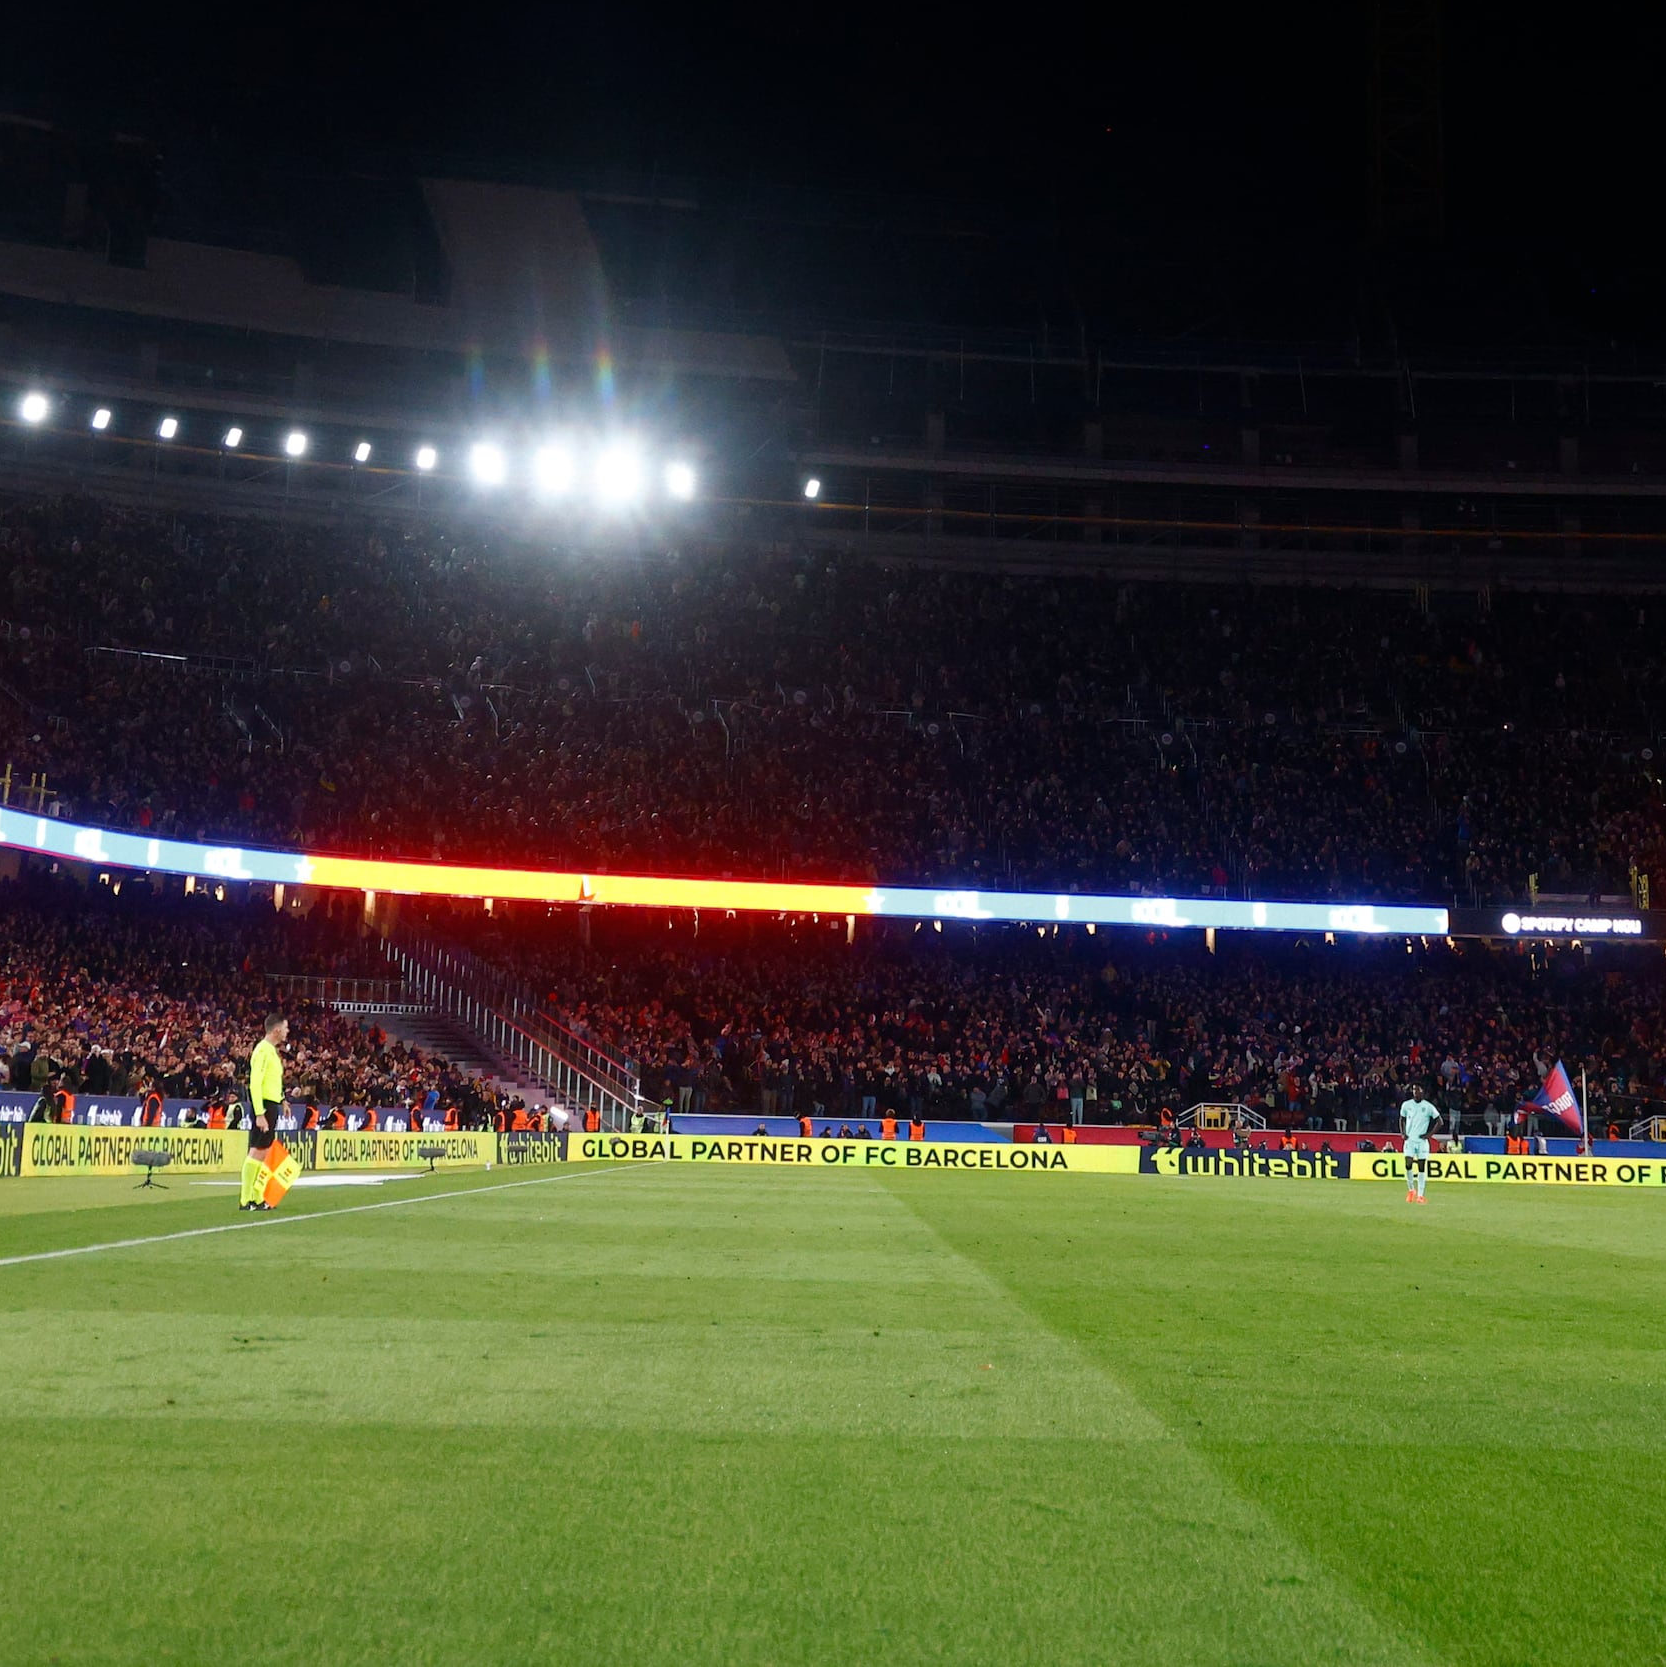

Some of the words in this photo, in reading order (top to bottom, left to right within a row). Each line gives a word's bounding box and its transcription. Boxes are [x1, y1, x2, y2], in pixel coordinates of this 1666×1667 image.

[1574, 918, 1612, 933] CAMP
[32, 1133, 75, 1166] GLOBAL
[79, 1135, 132, 1166] PARTNER
[323, 1138, 359, 1162] GLOBAL
[361, 1138, 400, 1162] PARTNER
[402, 1139, 414, 1161] OF
[582, 1139, 683, 1161] GLOBAL
[691, 1142, 812, 1163] PARTNER
[821, 1145, 857, 1165] OF
[865, 1146, 897, 1166] FC
[906, 1147, 1068, 1170] BARCELONA
[1186, 1148, 1339, 1179] whitebit
[1372, 1158, 1477, 1181] GLBAL
[1486, 1161, 1608, 1183] PARTNER
[1616, 1164, 1651, 1185] OF
